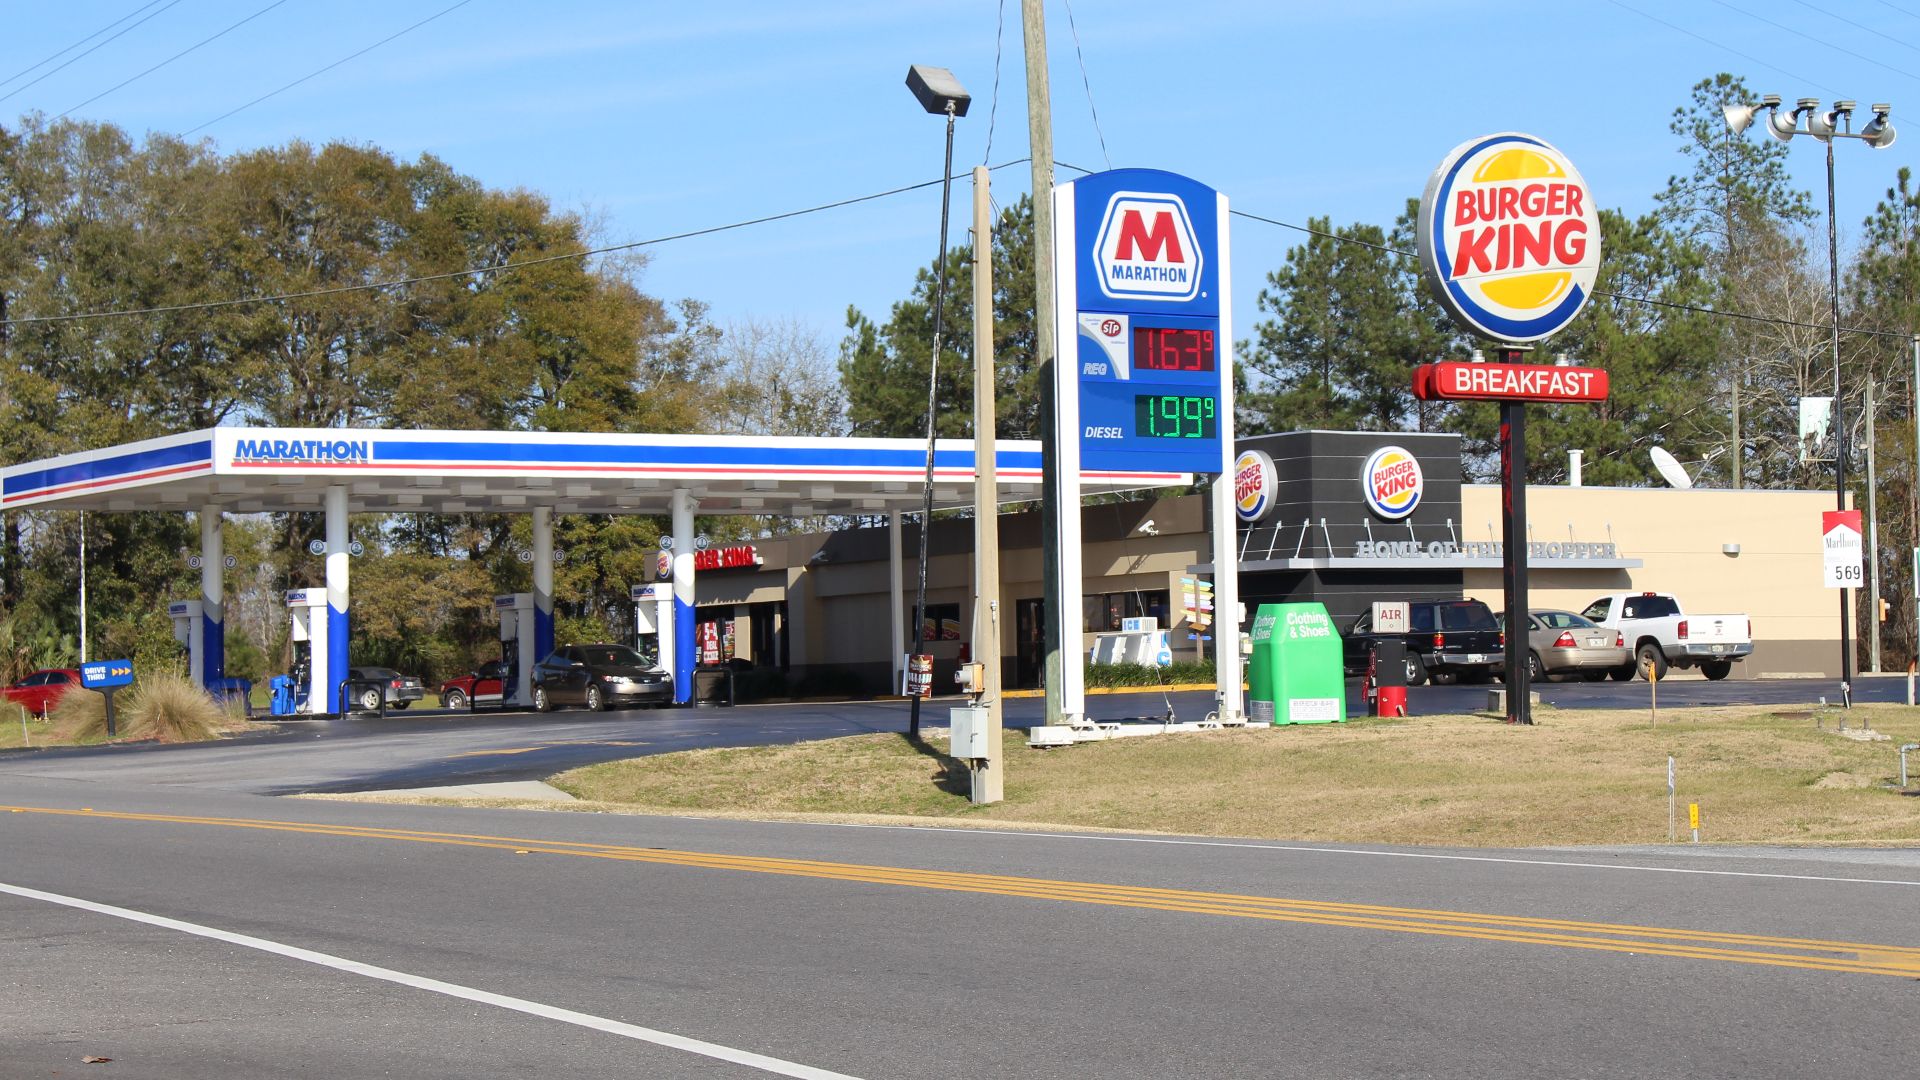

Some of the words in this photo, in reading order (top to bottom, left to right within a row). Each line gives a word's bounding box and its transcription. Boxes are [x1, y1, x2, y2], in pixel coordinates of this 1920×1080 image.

[1454, 183, 1584, 227] BURGER
[1115, 210, 1184, 263] M
[1452, 218, 1588, 277] KING
[1112, 265, 1187, 283] MARATHON
[1103, 321, 1120, 334] STP
[1083, 362, 1107, 375] REG
[1455, 367, 1594, 396] BREAKFAST
[1085, 426, 1124, 439] DIESEL
[235, 440, 368, 460] MARATHON
[1374, 461, 1414, 486] BURGER
[1235, 475, 1263, 502] KING
[1376, 472, 1417, 502] KING
[722, 545, 755, 567] KING
[1355, 541, 1422, 558] HOME
[1428, 541, 1457, 558] OF
[1527, 542, 1616, 559] HOPPER
[191, 558, 197, 566] 8
[227, 558, 234, 566] 7
[1835, 565, 1861, 580] 569
[1286, 611, 1329, 627] Clothing
[1381, 609, 1402, 620] AIR
[1123, 620, 1140, 631] ICE
[1289, 626, 1298, 639] &
[1299, 624, 1331, 638] Shoes
[85, 666, 106, 675] DRIVE
